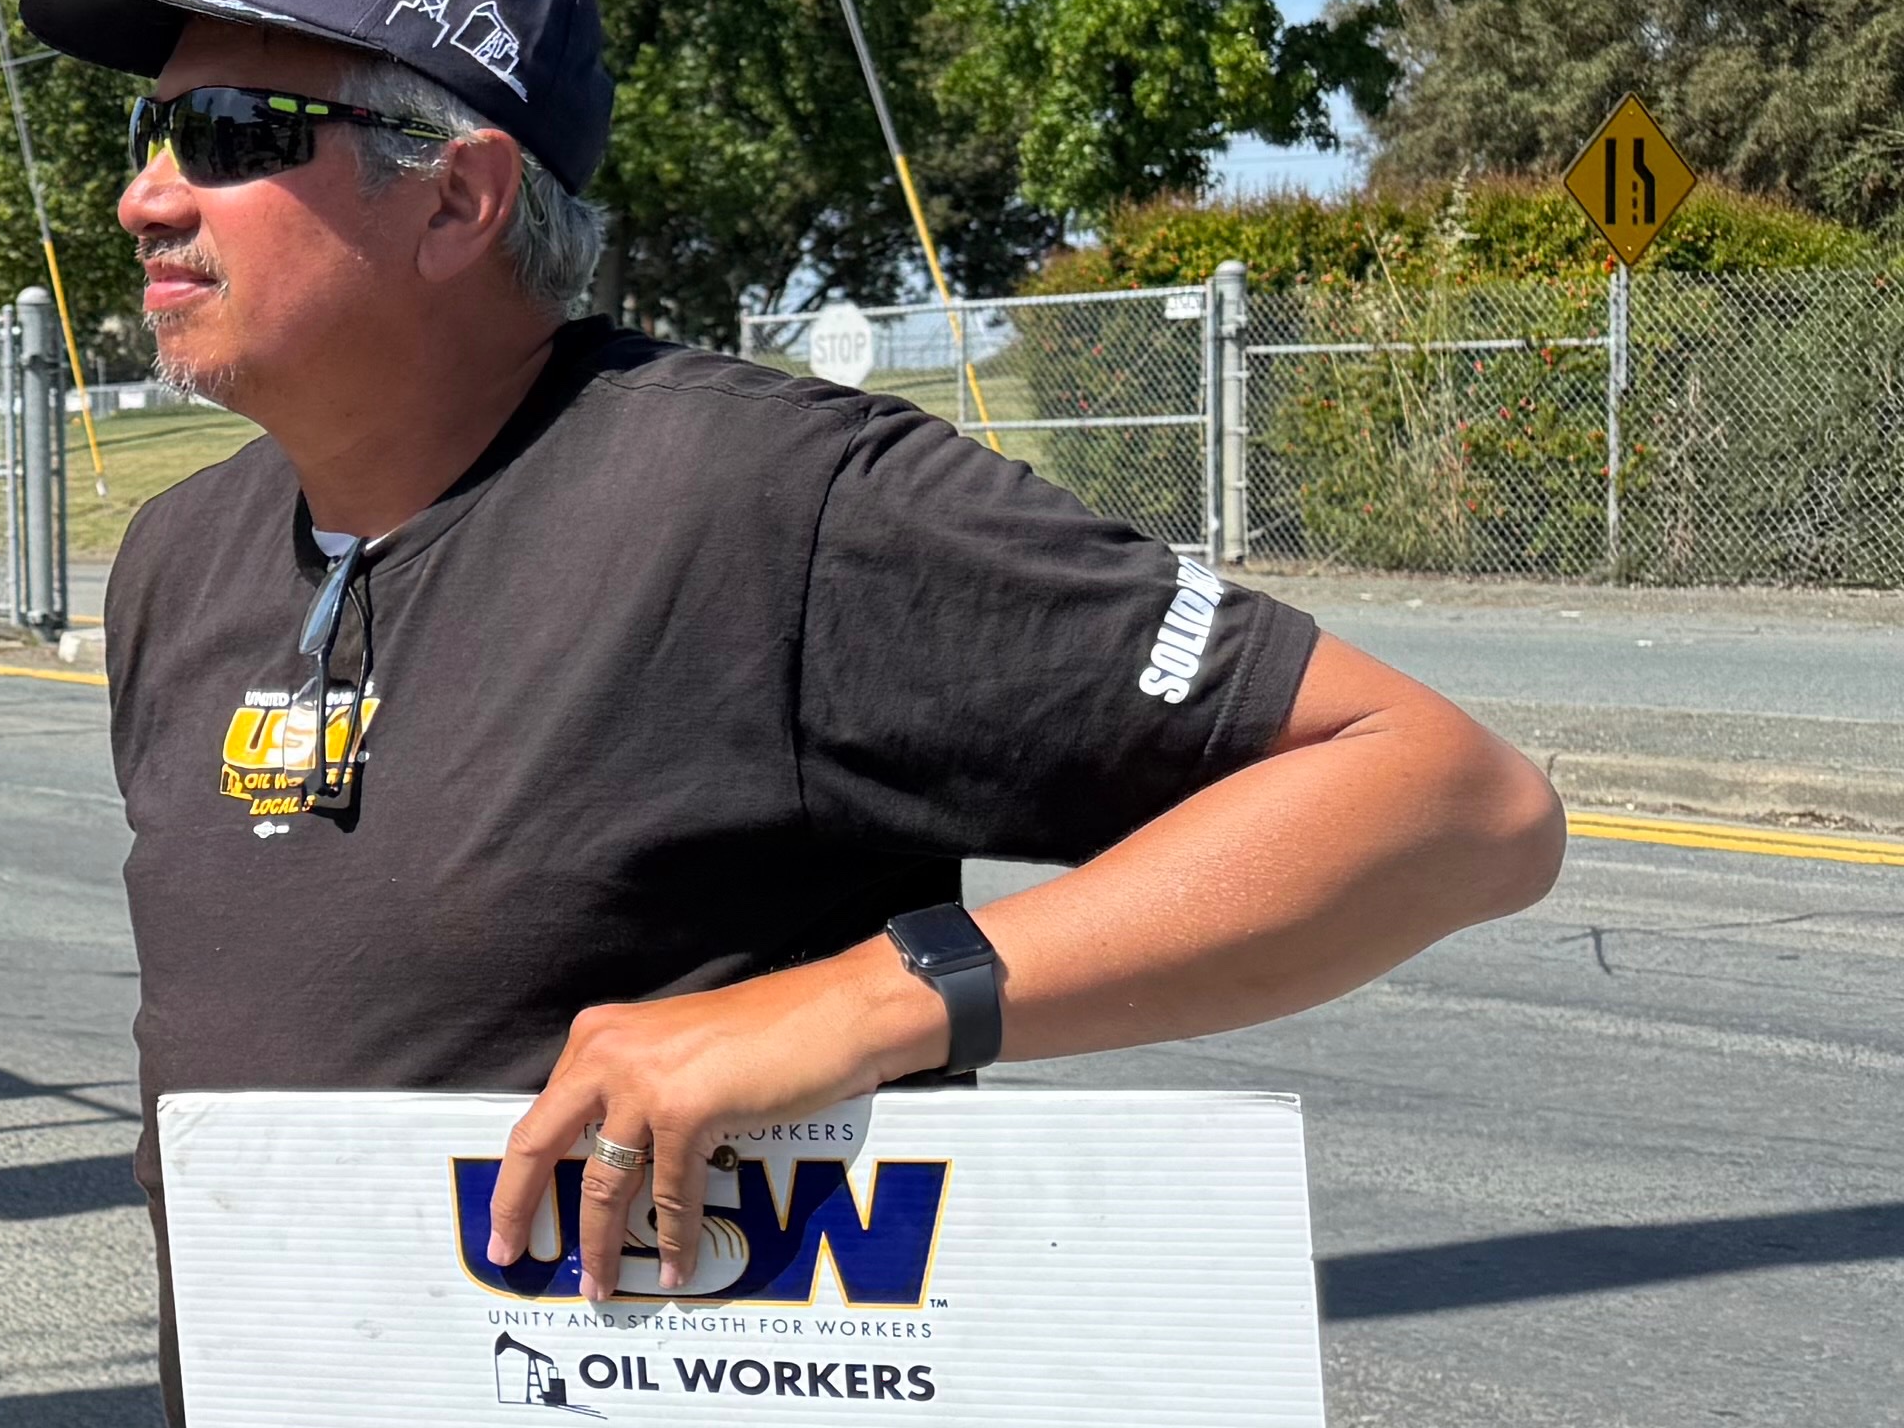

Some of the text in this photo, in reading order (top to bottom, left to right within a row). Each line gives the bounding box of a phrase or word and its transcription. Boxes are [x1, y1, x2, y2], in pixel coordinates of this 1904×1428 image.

[814, 331, 868, 365] STOP
[244, 772, 272, 789] OIL
[249, 796, 300, 816] LOCAL
[447, 1154, 953, 1310] USW
[487, 1309, 934, 1340] UNITY AND STRENGTH FOR WORKERS
[578, 1353, 937, 1402] OIL WORKERS
